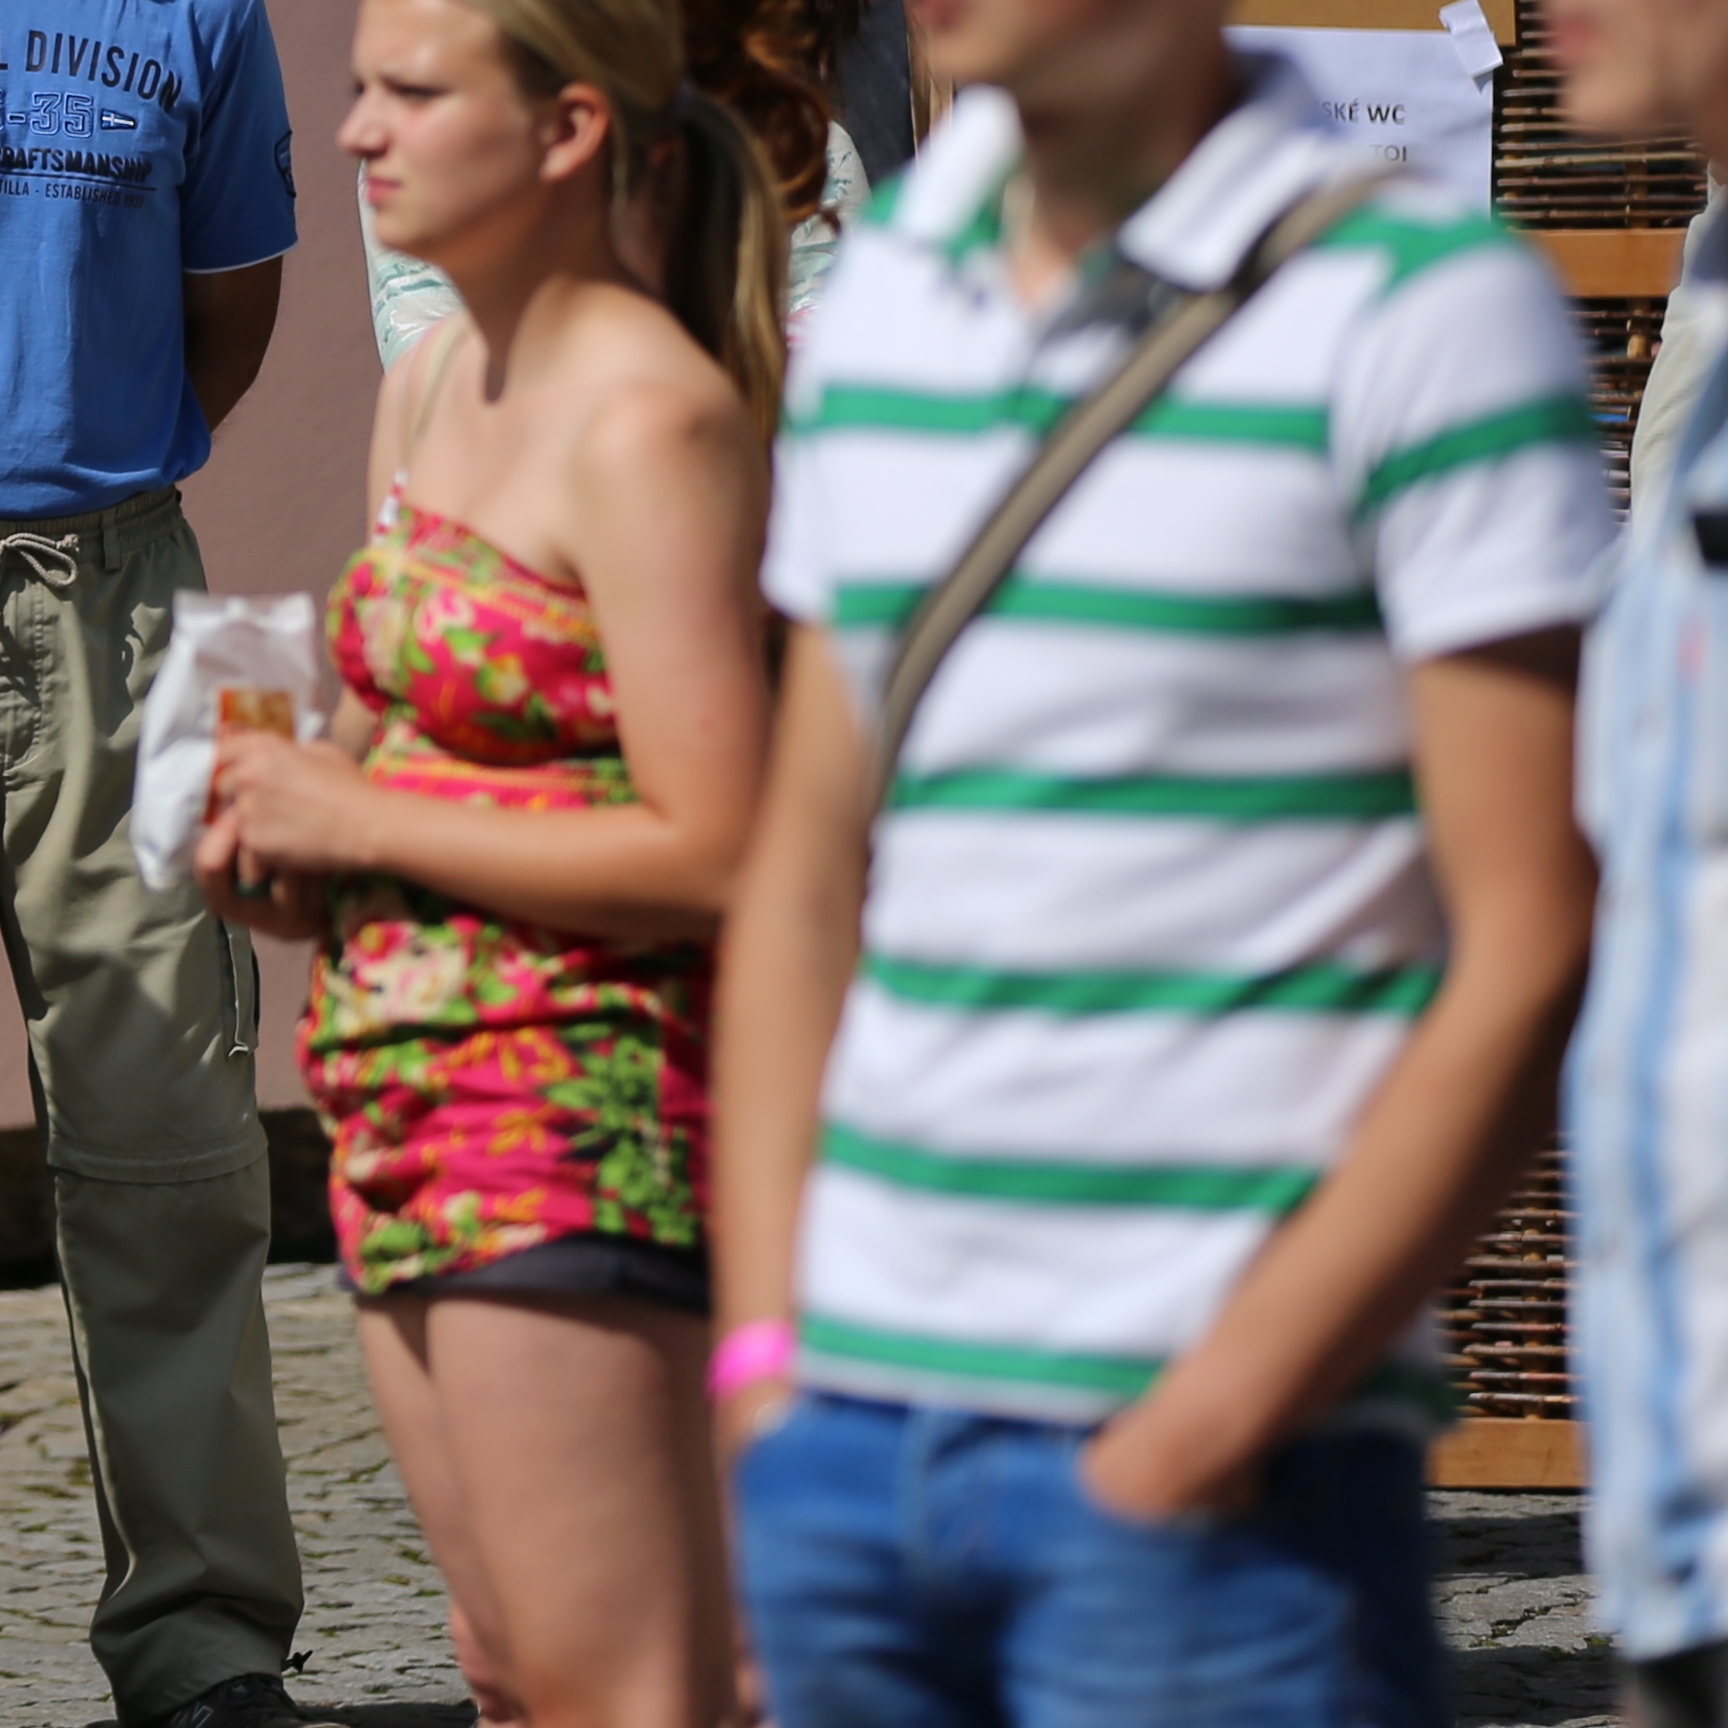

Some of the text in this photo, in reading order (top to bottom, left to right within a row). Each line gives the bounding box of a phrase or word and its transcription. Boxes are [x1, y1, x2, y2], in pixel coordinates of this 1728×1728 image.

[25, 29, 183, 113] DIVISION
[1366, 103, 1406, 125] WC
[45, 183, 122, 206] ESTABLISHED
